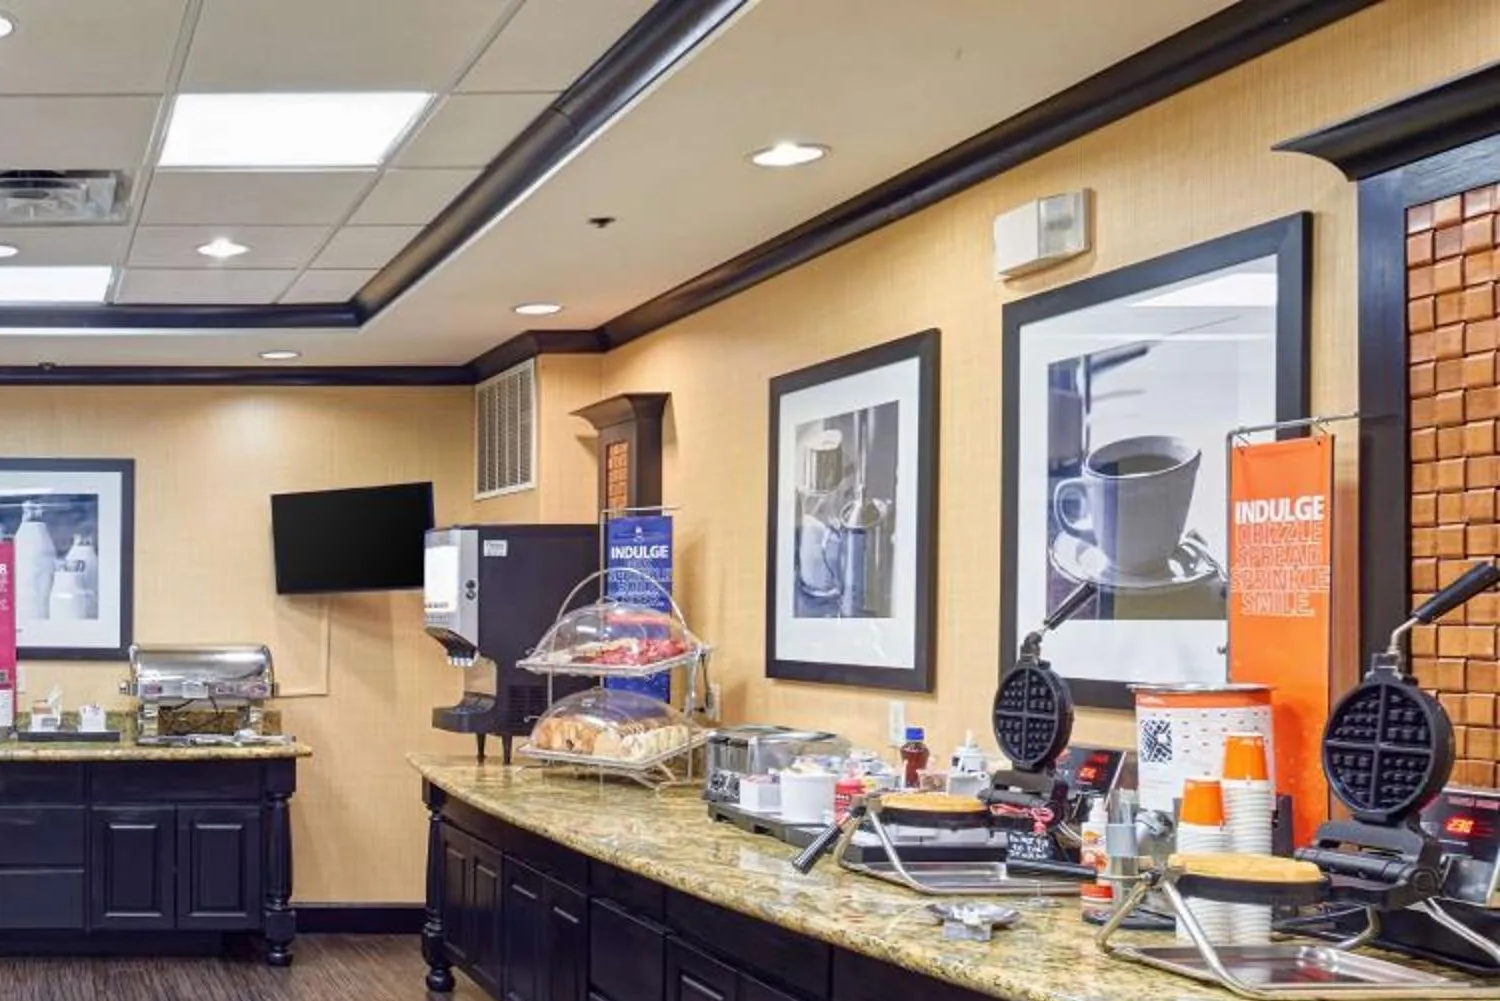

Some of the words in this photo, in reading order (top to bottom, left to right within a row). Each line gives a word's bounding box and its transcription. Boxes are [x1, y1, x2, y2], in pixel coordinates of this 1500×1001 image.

[1235, 496, 1325, 524] INDULGE
[1237, 521, 1323, 544] DRIZZLE
[611, 545, 669, 559] INDULGE
[1237, 544, 1321, 567] SPREAD
[1231, 566, 1330, 591] SPRINKLE
